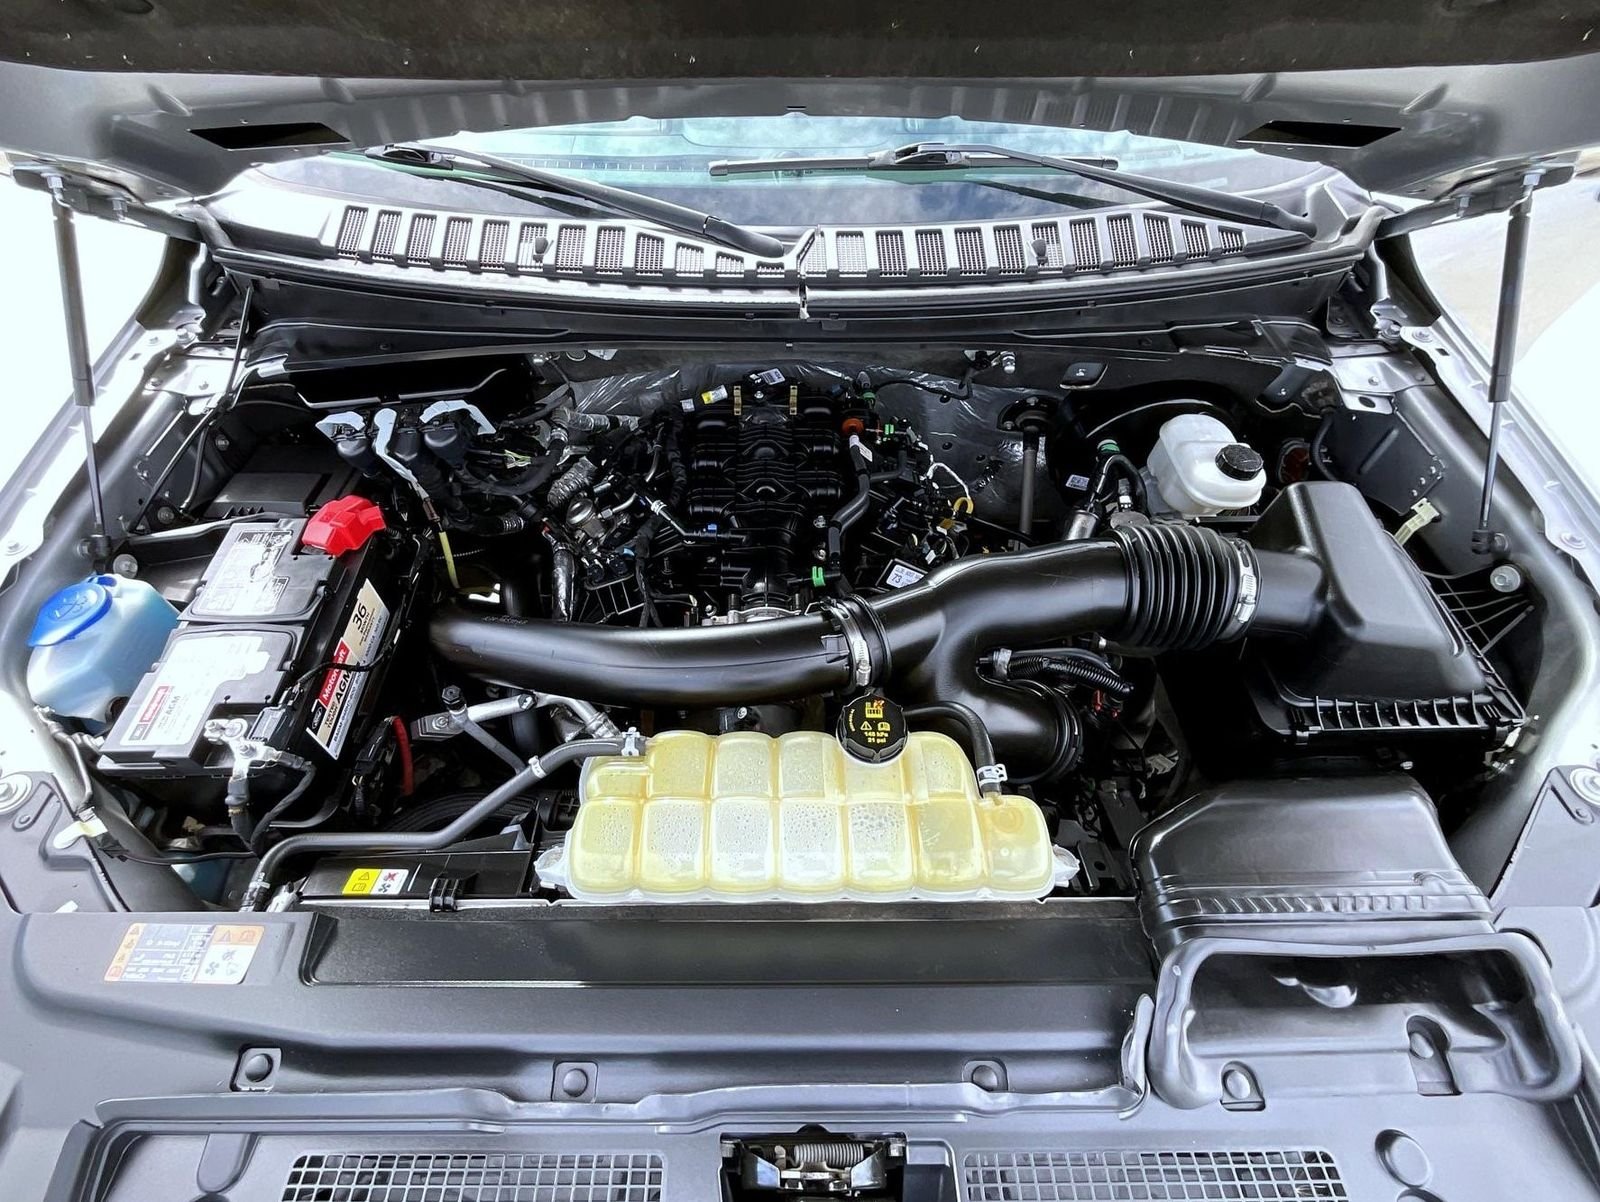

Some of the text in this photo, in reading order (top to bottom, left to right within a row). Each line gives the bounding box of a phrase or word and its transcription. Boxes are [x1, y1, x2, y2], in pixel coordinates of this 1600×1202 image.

[892, 573, 903, 584] 73
[352, 602, 367, 630] 36
[360, 612, 370, 633] MONTH
[335, 668, 352, 704] AGM
